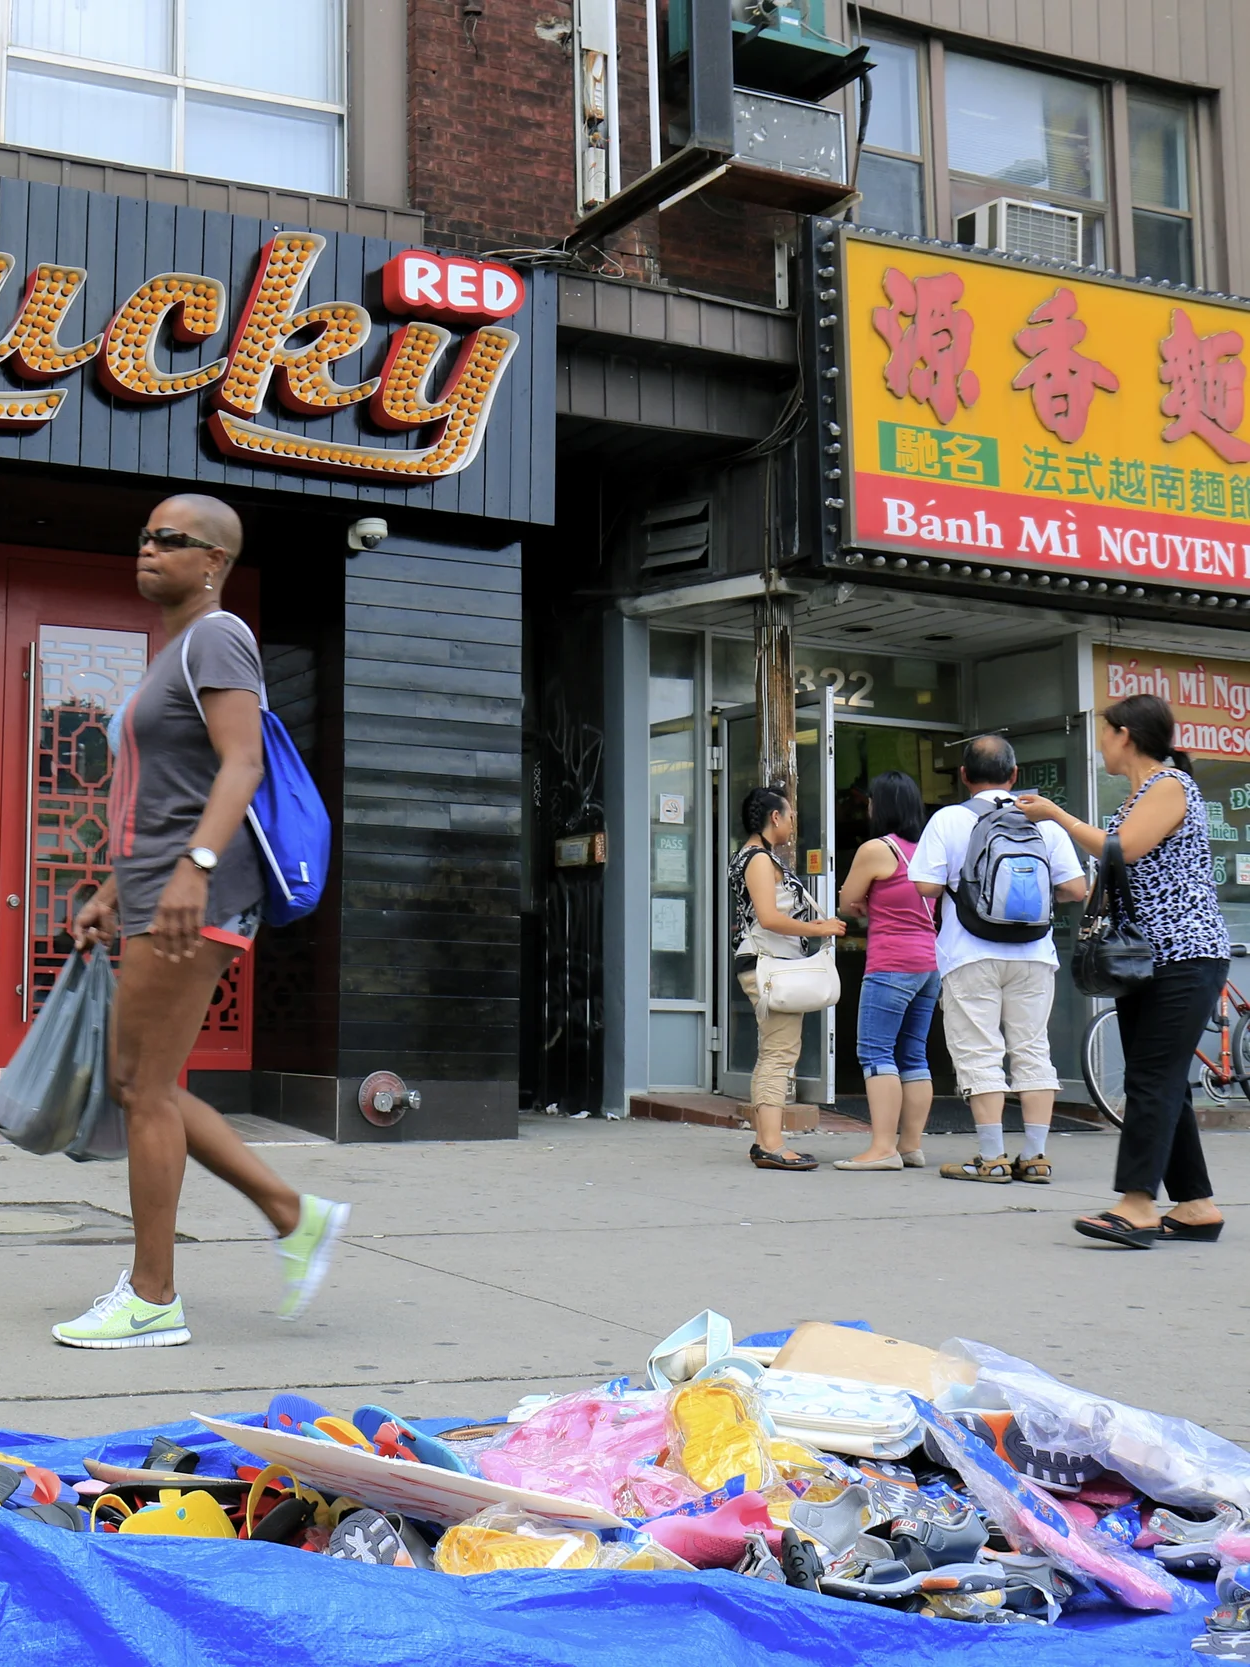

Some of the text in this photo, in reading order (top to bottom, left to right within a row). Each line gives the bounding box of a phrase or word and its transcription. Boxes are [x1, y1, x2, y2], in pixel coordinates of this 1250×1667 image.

[403, 257, 518, 312] RED
[895, 426, 984, 482] 馳名
[882, 497, 1004, 550] Bánh
[1097, 525, 1235, 578] NGUYEN
[794, 665, 874, 708] 322
[1108, 661, 1171, 702] Bánh
[661, 838, 683, 850] PASS
